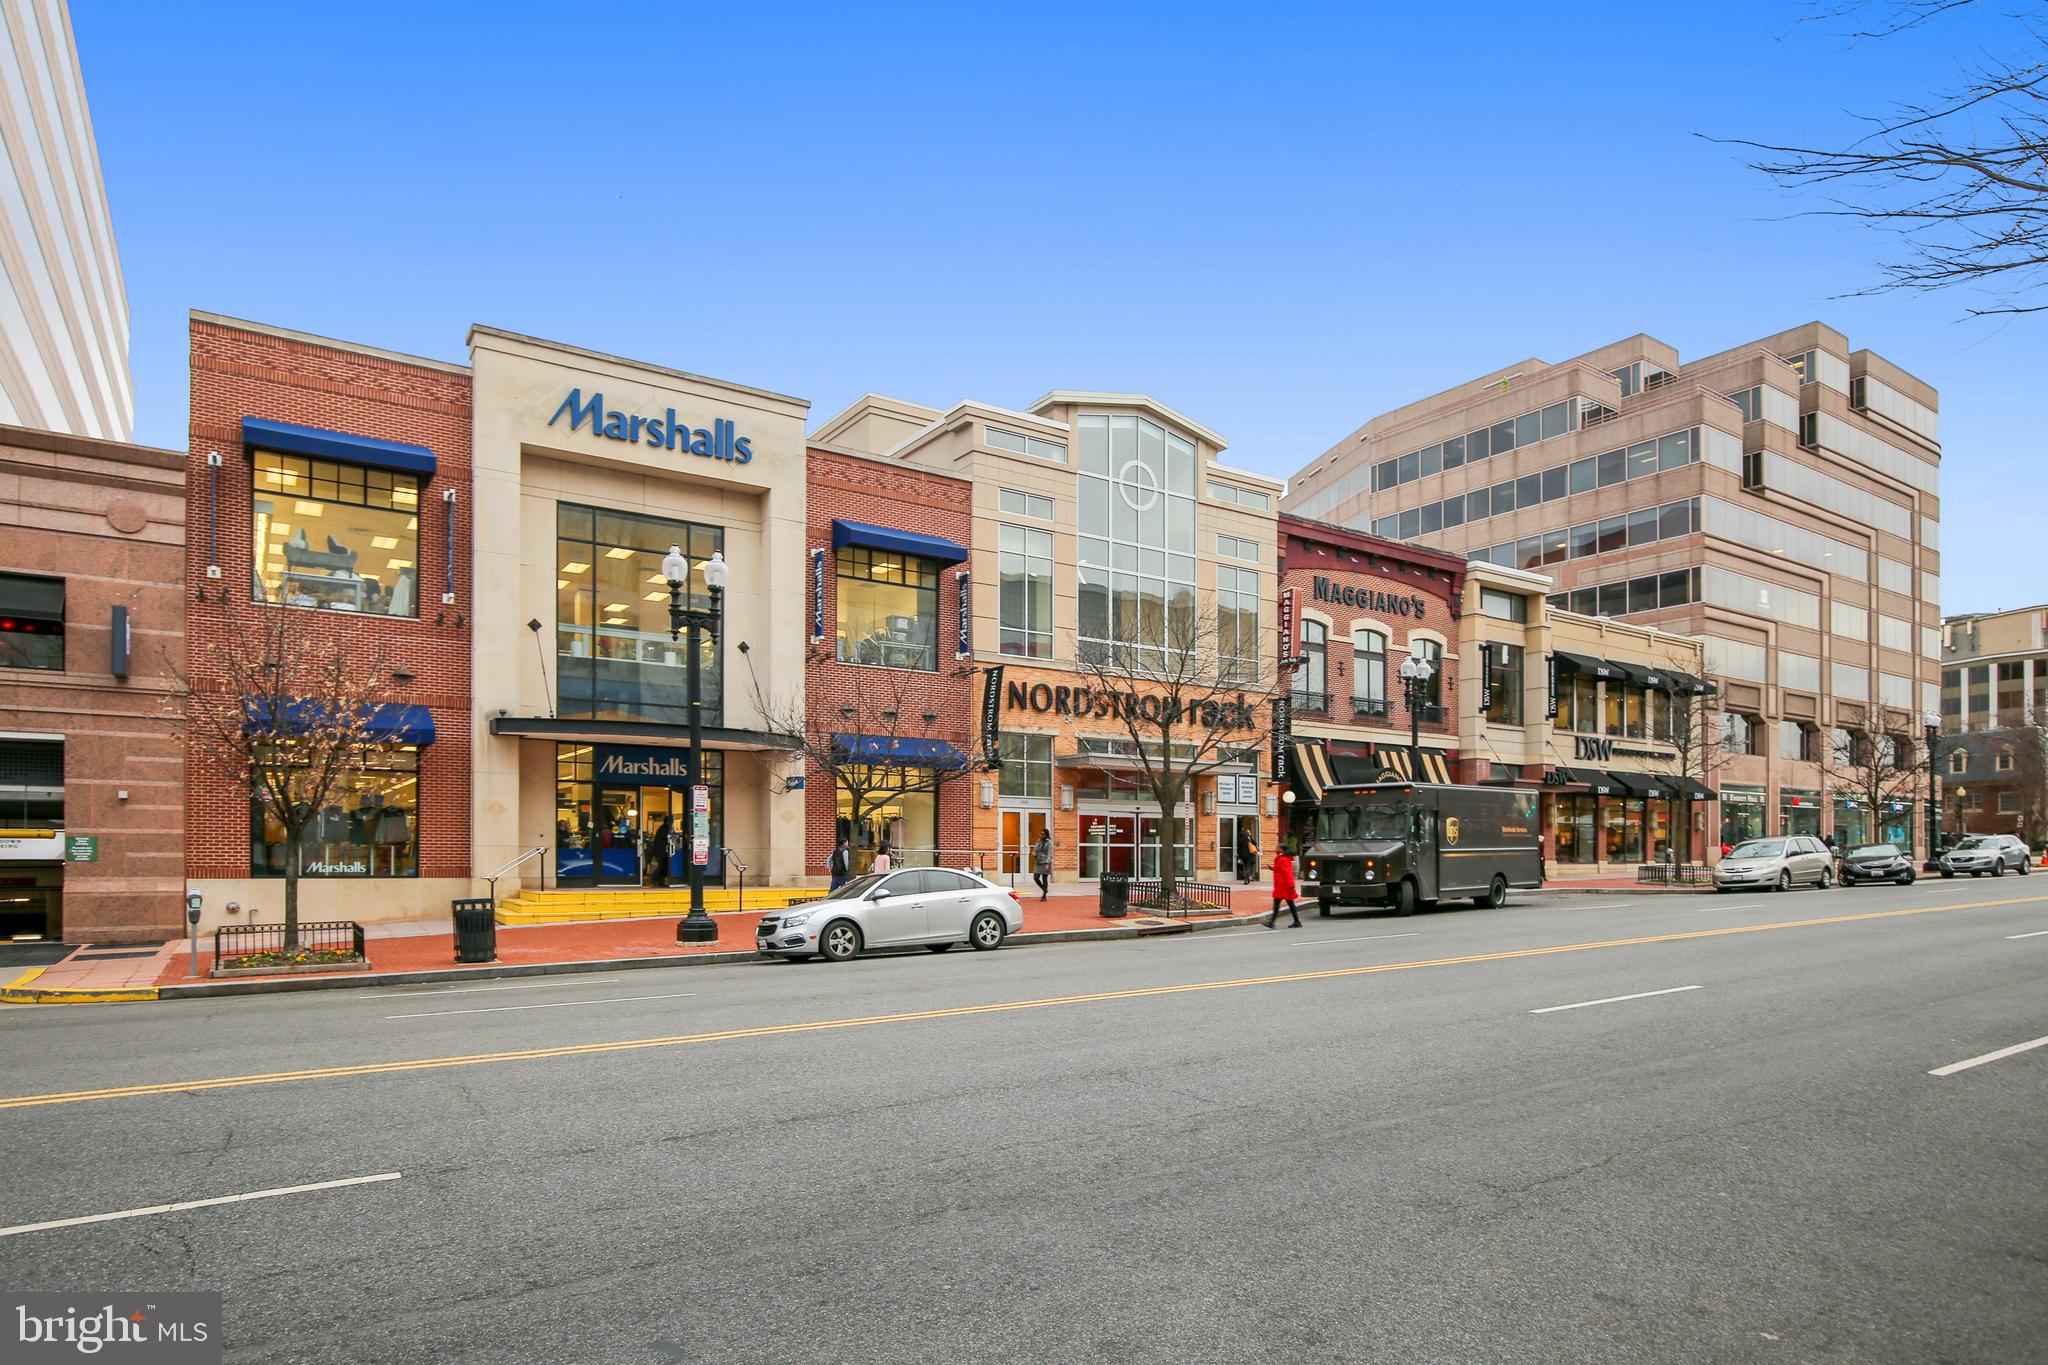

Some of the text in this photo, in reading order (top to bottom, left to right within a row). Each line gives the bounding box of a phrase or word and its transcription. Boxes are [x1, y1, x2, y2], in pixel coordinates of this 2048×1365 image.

[549, 388, 753, 464] Marshalls
[815, 560, 824, 627] Marshalls
[960, 583, 968, 644] Marshalls
[1314, 576, 1425, 618] MAGGIANO'S
[986, 670, 998, 731] NORDSTROM
[1008, 680, 1183, 724] NORDSTROM
[600, 755, 688, 777] Marshalls
[1278, 756, 1286, 778] rack
[1574, 736, 1613, 762] DSW
[306, 861, 367, 873] Marshalls
